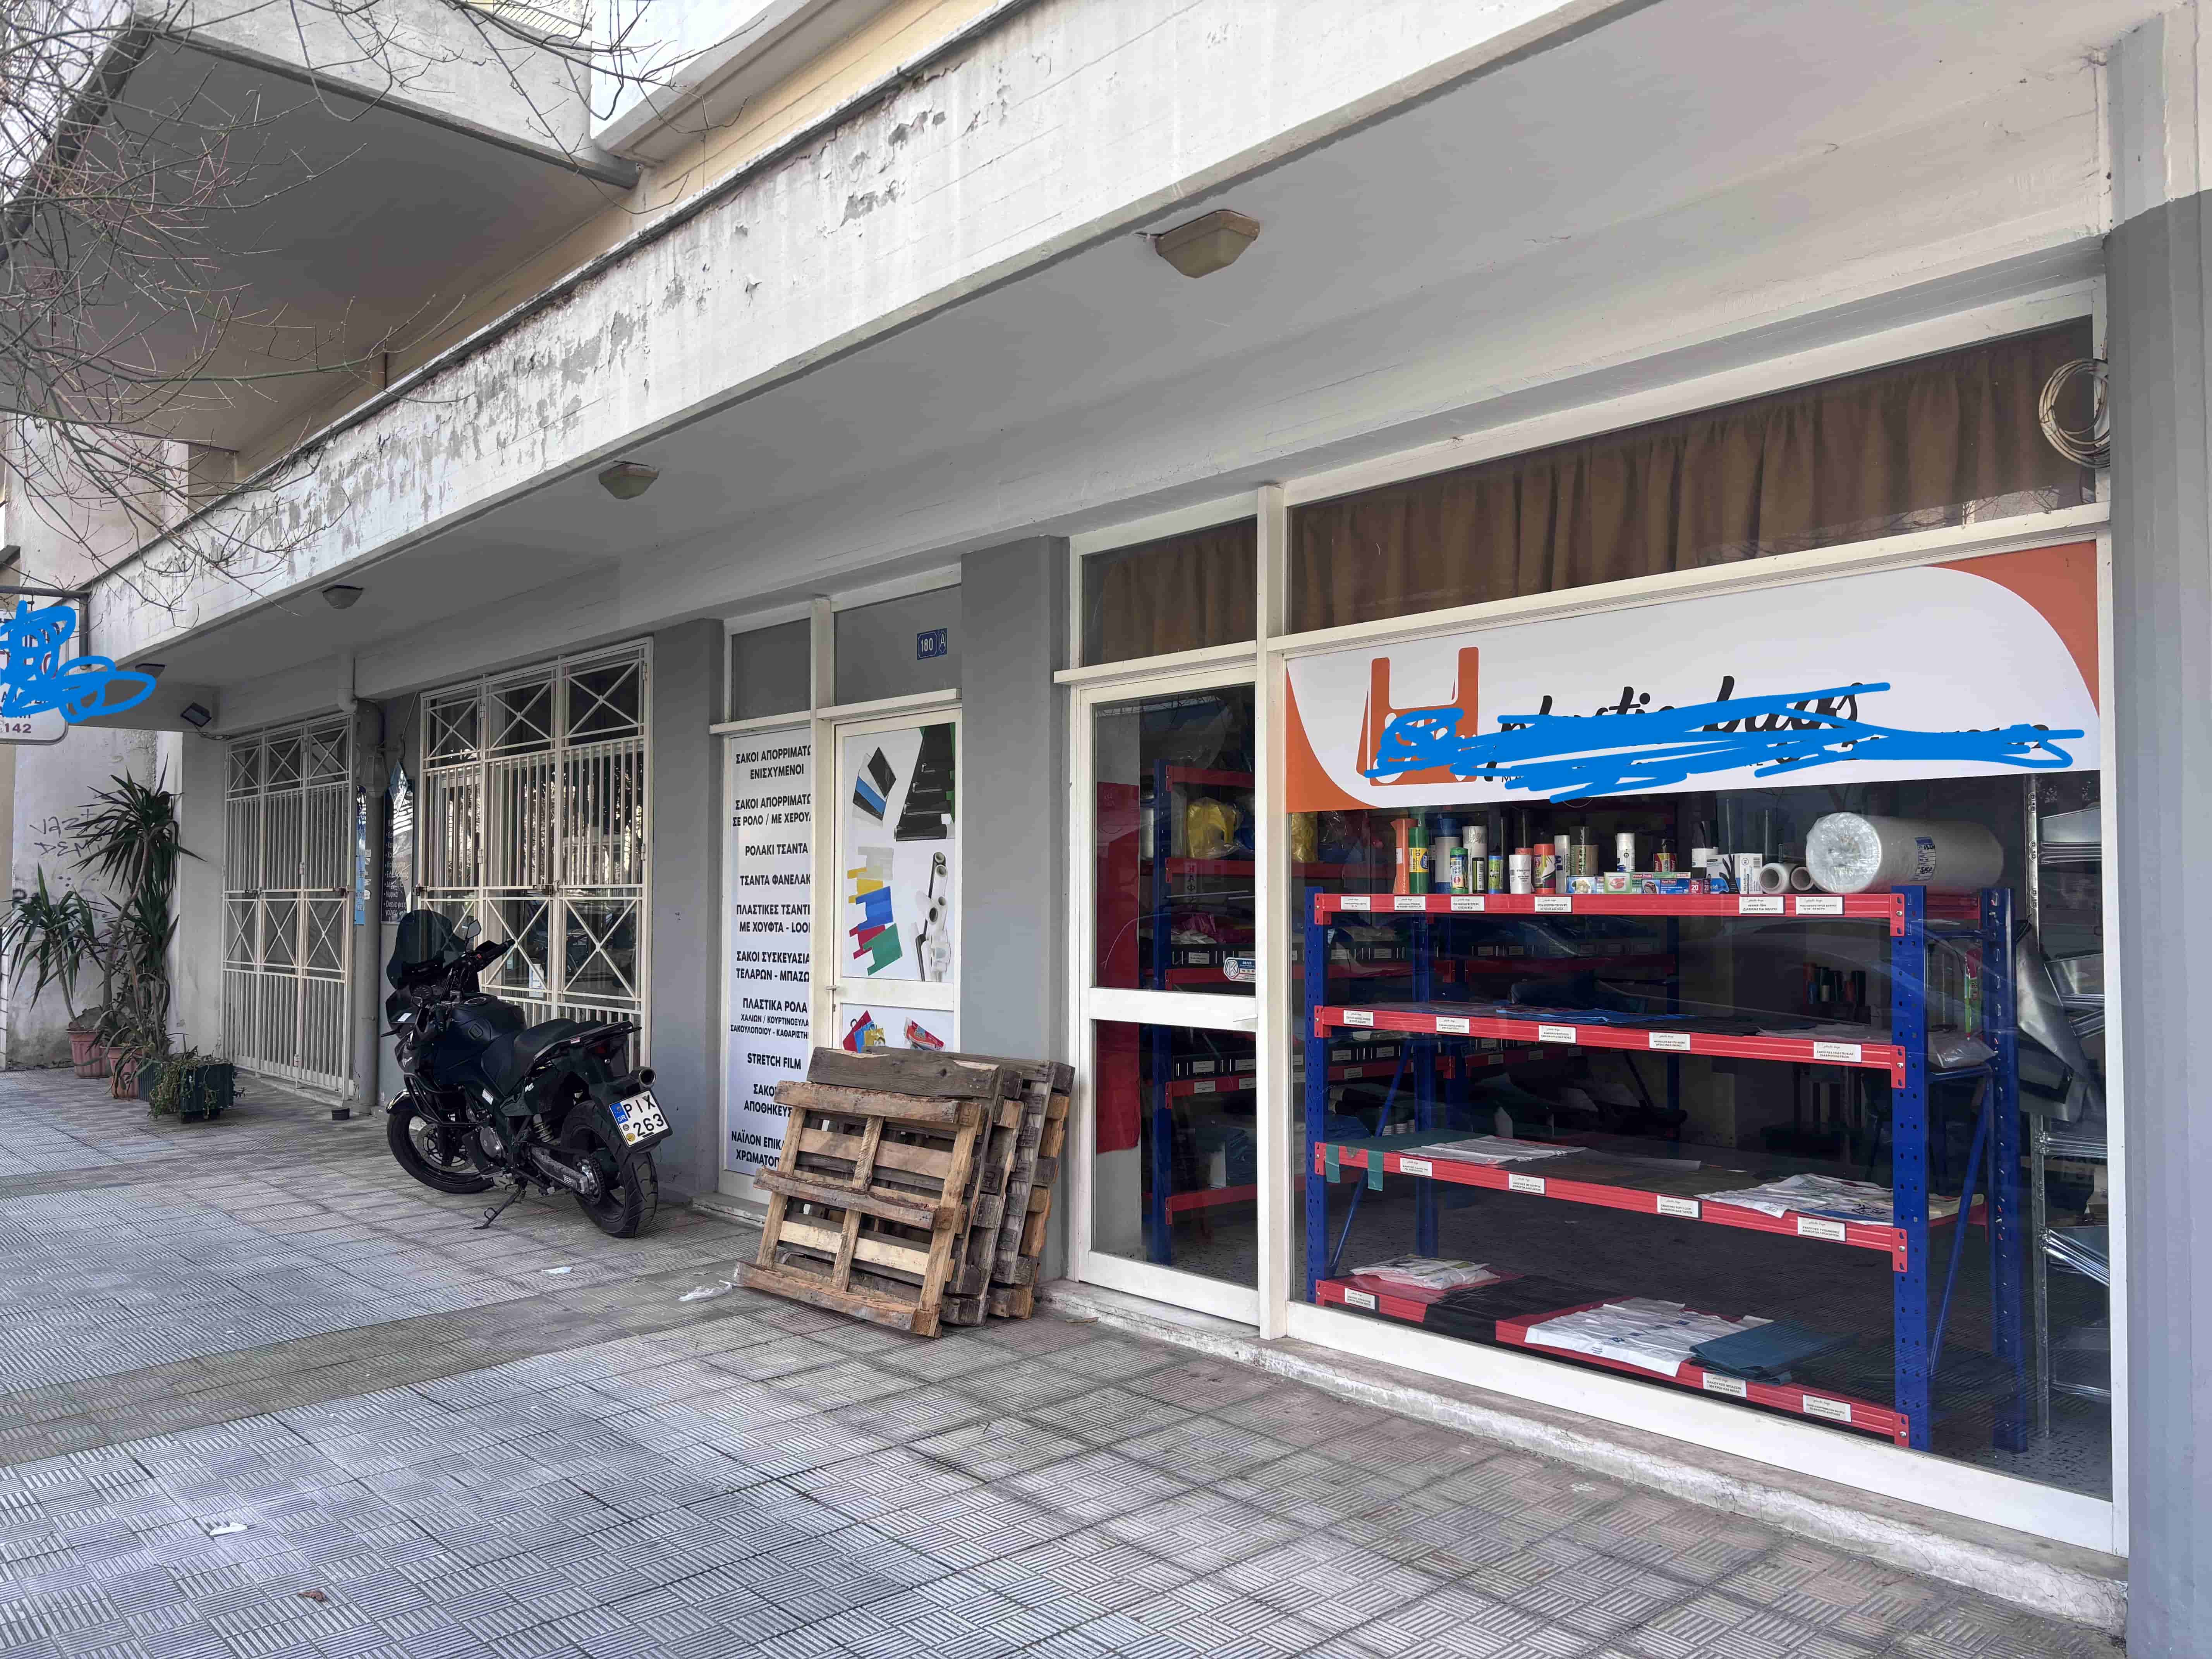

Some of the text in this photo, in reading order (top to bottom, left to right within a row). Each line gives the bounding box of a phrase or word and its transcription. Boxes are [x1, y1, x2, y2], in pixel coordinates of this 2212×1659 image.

[921, 638, 933, 652] 180
[5, 723, 31, 733] 142
[736, 751, 759, 764] ΣΑΚΟΙ
[750, 764, 804, 780] ΕΝΙΣΧΥΜΕΝΟΙ
[735, 798, 758, 810] ΣΑΚΟΙ
[733, 817, 741, 826] ΣΕ
[743, 815, 763, 826] ΡΟΛΟ
[771, 814, 782, 824] ΜΕ
[784, 812, 811, 823] ΧΕΡΟΥ
[745, 843, 808, 856] ΡΟΛΑΚΙ ΤΣΑΝΤΑ
[740, 874, 810, 886] ΤΣΑΝΤΑ ΦΑΝΕΛΑΚ
[737, 904, 779, 915] ΠΛΑΣΤΙΚΕΣ
[739, 922, 750, 932] ΜΕ
[752, 921, 784, 933] ΧΟΥΦΤΑ
[737, 951, 810, 964] ΣΑΚΟΙ ΣΥΣΚΕΥΑΣΙΑ
[736, 968, 772, 980] ΤΕΛΑΡΩΝ
[780, 970, 809, 982] ΜΠΑΖΩ
[743, 998, 807, 1013] ΠΛΑΣΤΙΚΑ ΡΟΛΑ
[741, 1014, 762, 1022] ΧΑΛΙΩΝ
[730, 1025, 771, 1035] ΣΑΚΟΥΛΟΠΟΙΟΥ
[776, 1029, 809, 1039] ΚΑΘΑΡΙΣΤΗ
[747, 1053, 801, 1070] STRETCH FILM
[753, 1084, 776, 1097] ΣΑΚΟ
[633, 1113, 664, 1137] 263
[732, 1129, 761, 1146] ΝΑΪΛΟΝ
